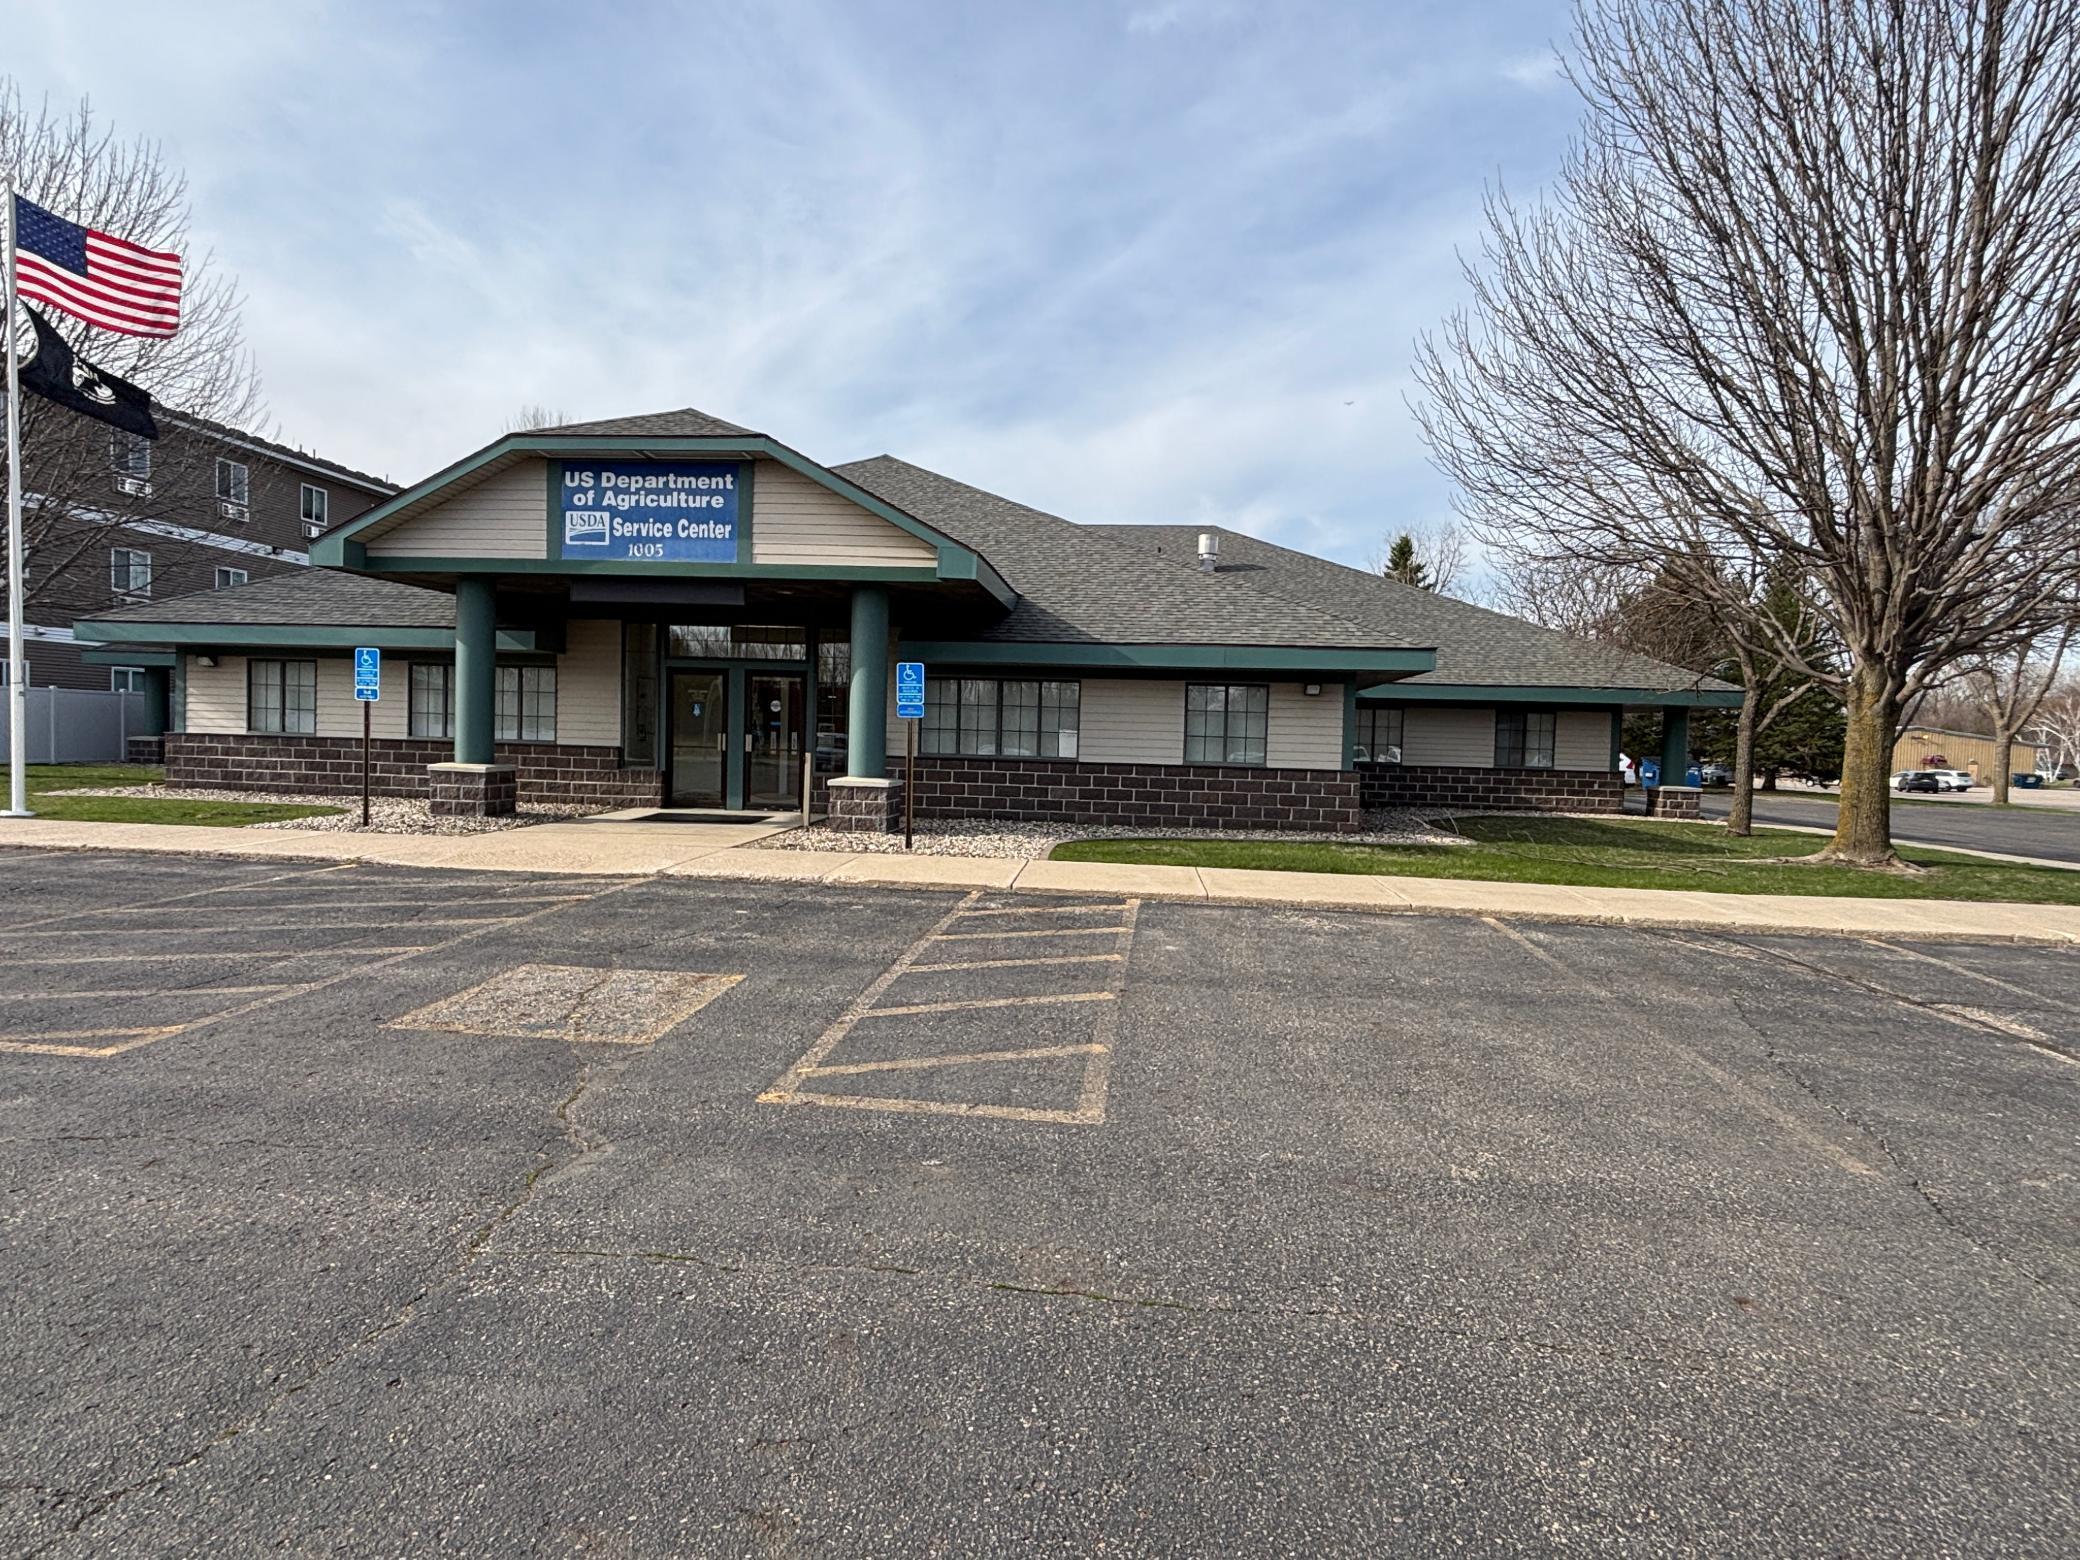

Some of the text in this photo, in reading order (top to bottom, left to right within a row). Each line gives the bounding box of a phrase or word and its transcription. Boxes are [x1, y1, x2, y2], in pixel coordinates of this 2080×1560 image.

[565, 471, 734, 491] US Department
[573, 490, 724, 510] of Agriculture
[569, 513, 606, 527] USDA
[613, 517, 731, 539] Service Center
[628, 543, 663, 557] 1005
